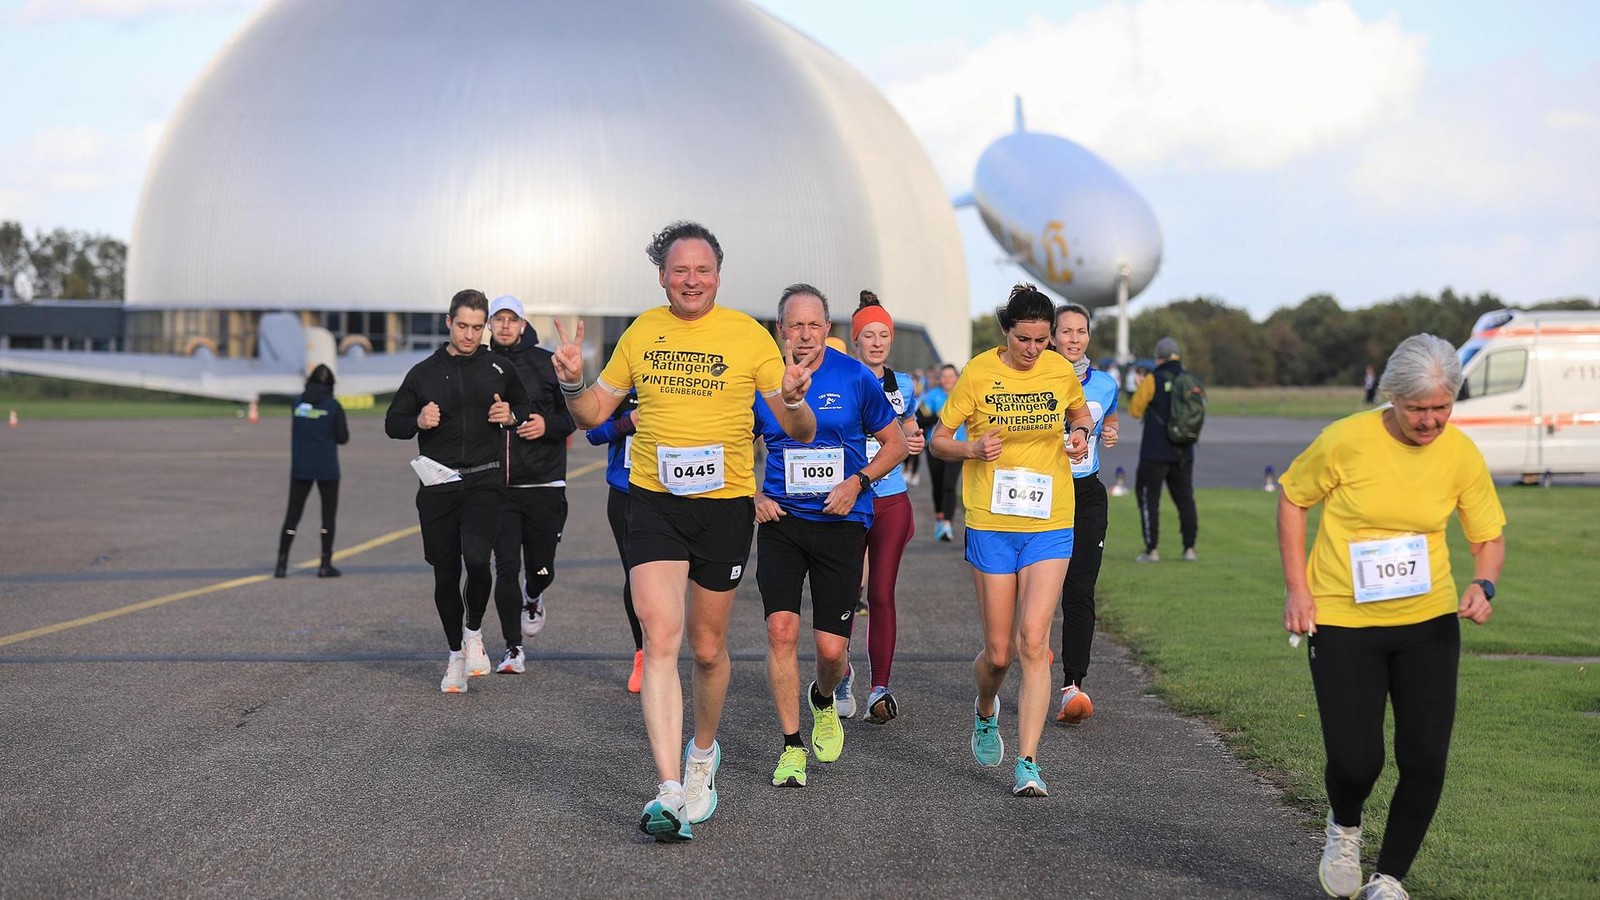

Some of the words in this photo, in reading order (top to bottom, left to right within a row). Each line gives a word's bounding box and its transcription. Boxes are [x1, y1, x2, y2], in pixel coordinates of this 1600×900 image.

[644, 350, 723, 364] Stadtwerke
[652, 360, 710, 375] Ratingen
[649, 375, 726, 391] INTERSPORT
[660, 386, 713, 397] EGENBERGER
[985, 392, 1054, 404] Stadtwerke
[995, 402, 1047, 413] Ratingen
[997, 413, 1060, 425] INTERSPORT
[1007, 424, 1053, 432] EGENBERGER
[673, 463, 716, 479] 0445
[802, 466, 834, 478] 1030
[1008, 488, 1044, 503] 0447
[1375, 560, 1416, 579] 1067
